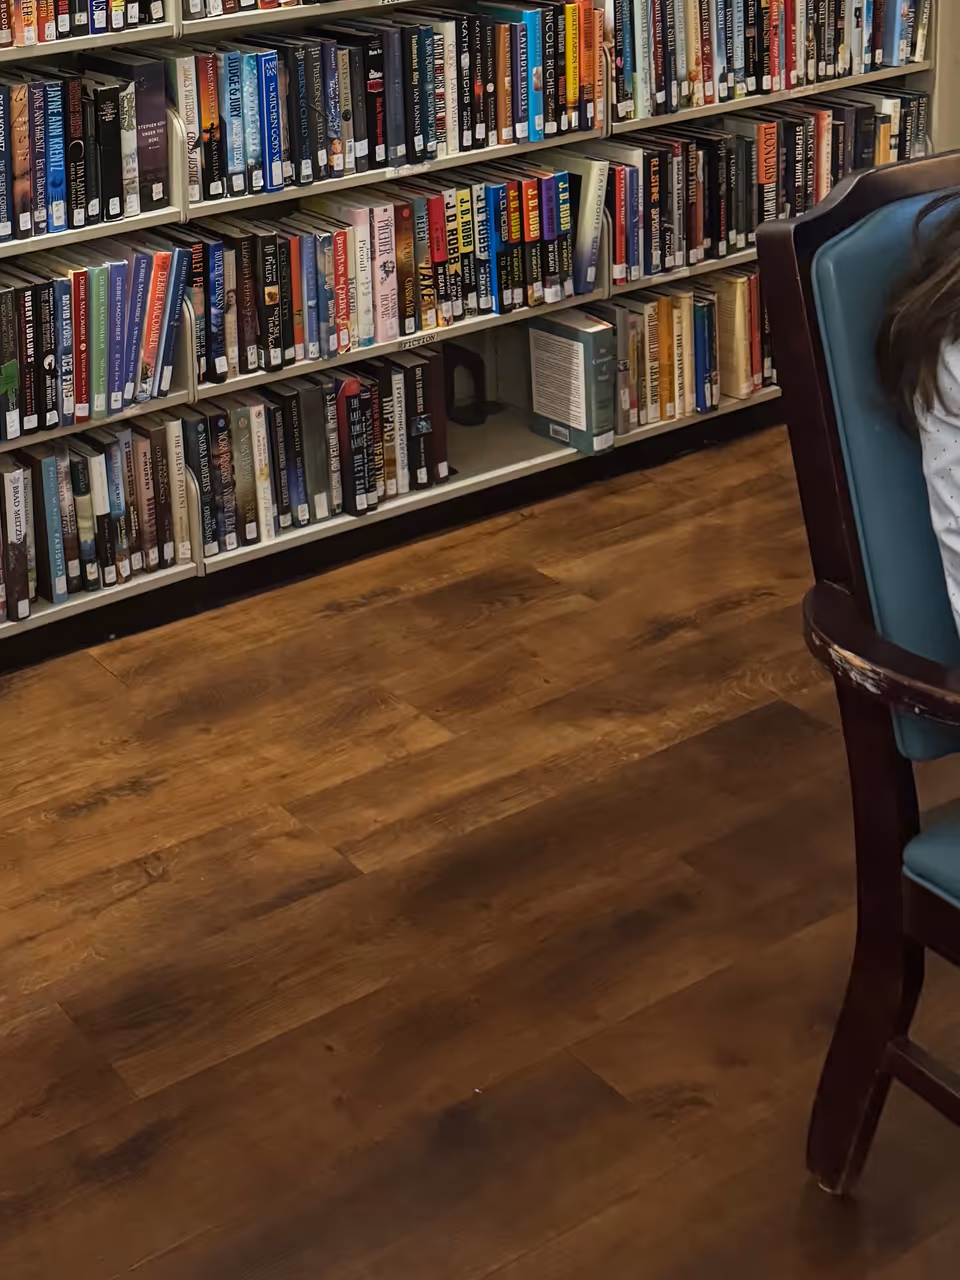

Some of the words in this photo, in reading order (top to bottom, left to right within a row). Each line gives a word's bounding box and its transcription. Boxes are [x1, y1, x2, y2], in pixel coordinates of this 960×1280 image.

[544, 11, 554, 54] NICOLE
[226, 56, 239, 87] JUDGE
[545, 58, 555, 95] RICHIE
[47, 87, 61, 114] JAYNE
[229, 88, 240, 96] &
[229, 97, 241, 118] JURY
[49, 116, 62, 136] ANN
[49, 138, 63, 172] KRENTZ
[795, 126, 803, 161] STEPHEN
[795, 163, 803, 187] WHITE
[419, 265, 435, 301] TAKE
[403, 334, 436, 348] FICTION
[383, 397, 396, 447] IMPACT
